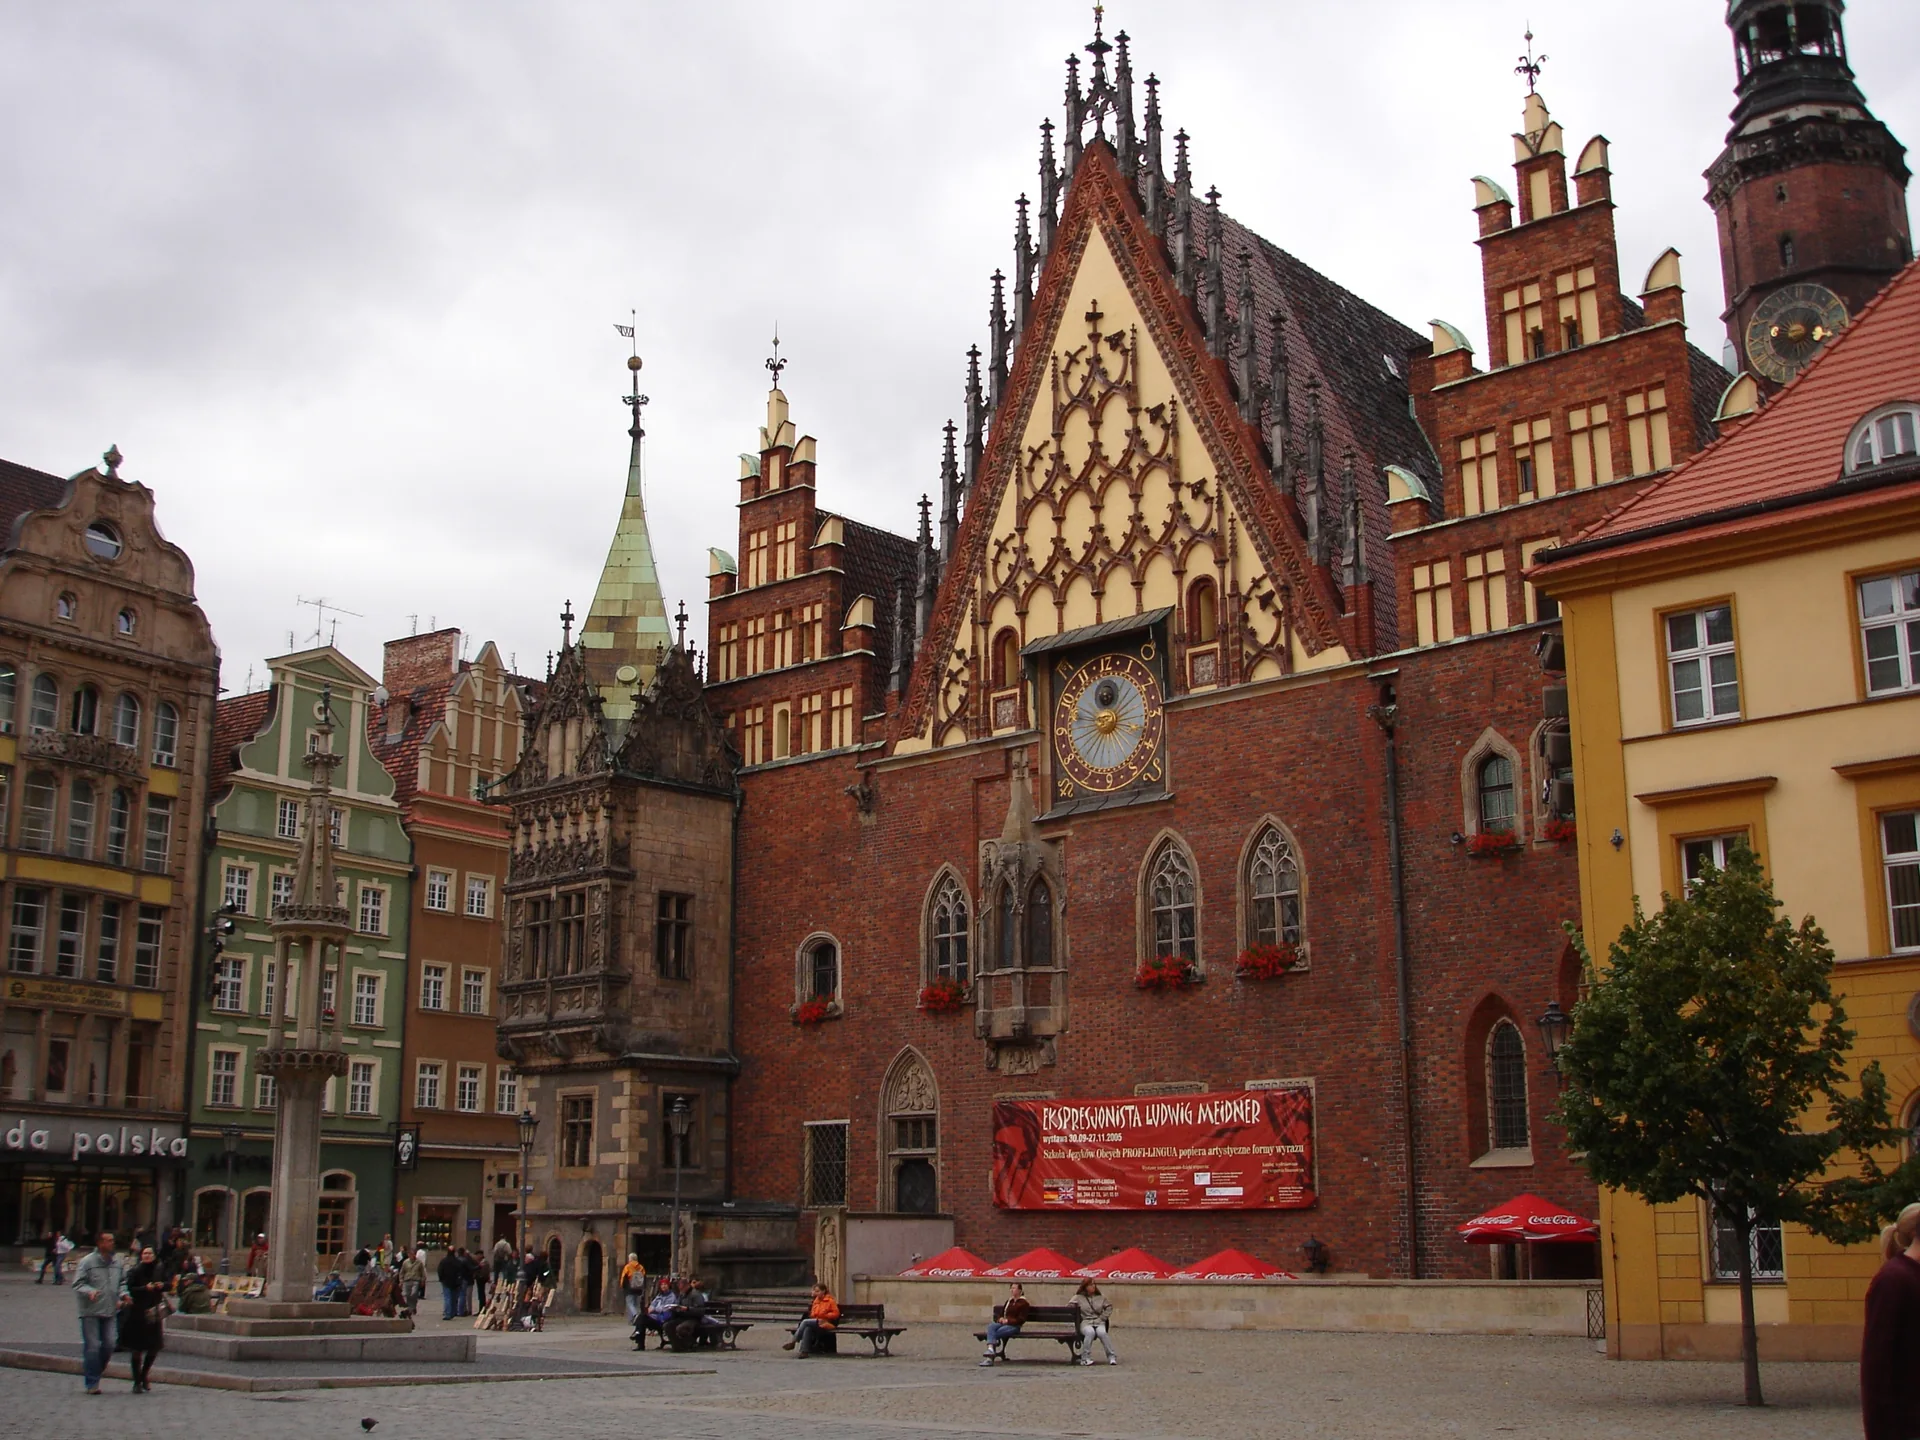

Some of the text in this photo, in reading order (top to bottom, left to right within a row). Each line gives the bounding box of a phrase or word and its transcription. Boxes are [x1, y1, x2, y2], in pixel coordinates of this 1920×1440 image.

[1100, 657, 1112, 672] 12
[1078, 670, 1089, 684] 11
[1061, 693, 1075, 708] 10
[0, 1119, 188, 1161] da polska
[1122, 1147, 1178, 1158] PROFI-LINGUA
[1179, 1148, 1206, 1159] popiera
[1208, 1146, 1251, 1157] artystyczne
[1252, 1144, 1274, 1157] formy
[1274, 1144, 1304, 1155] wyrazu
[1528, 1215, 1578, 1225] Coca-Cola
